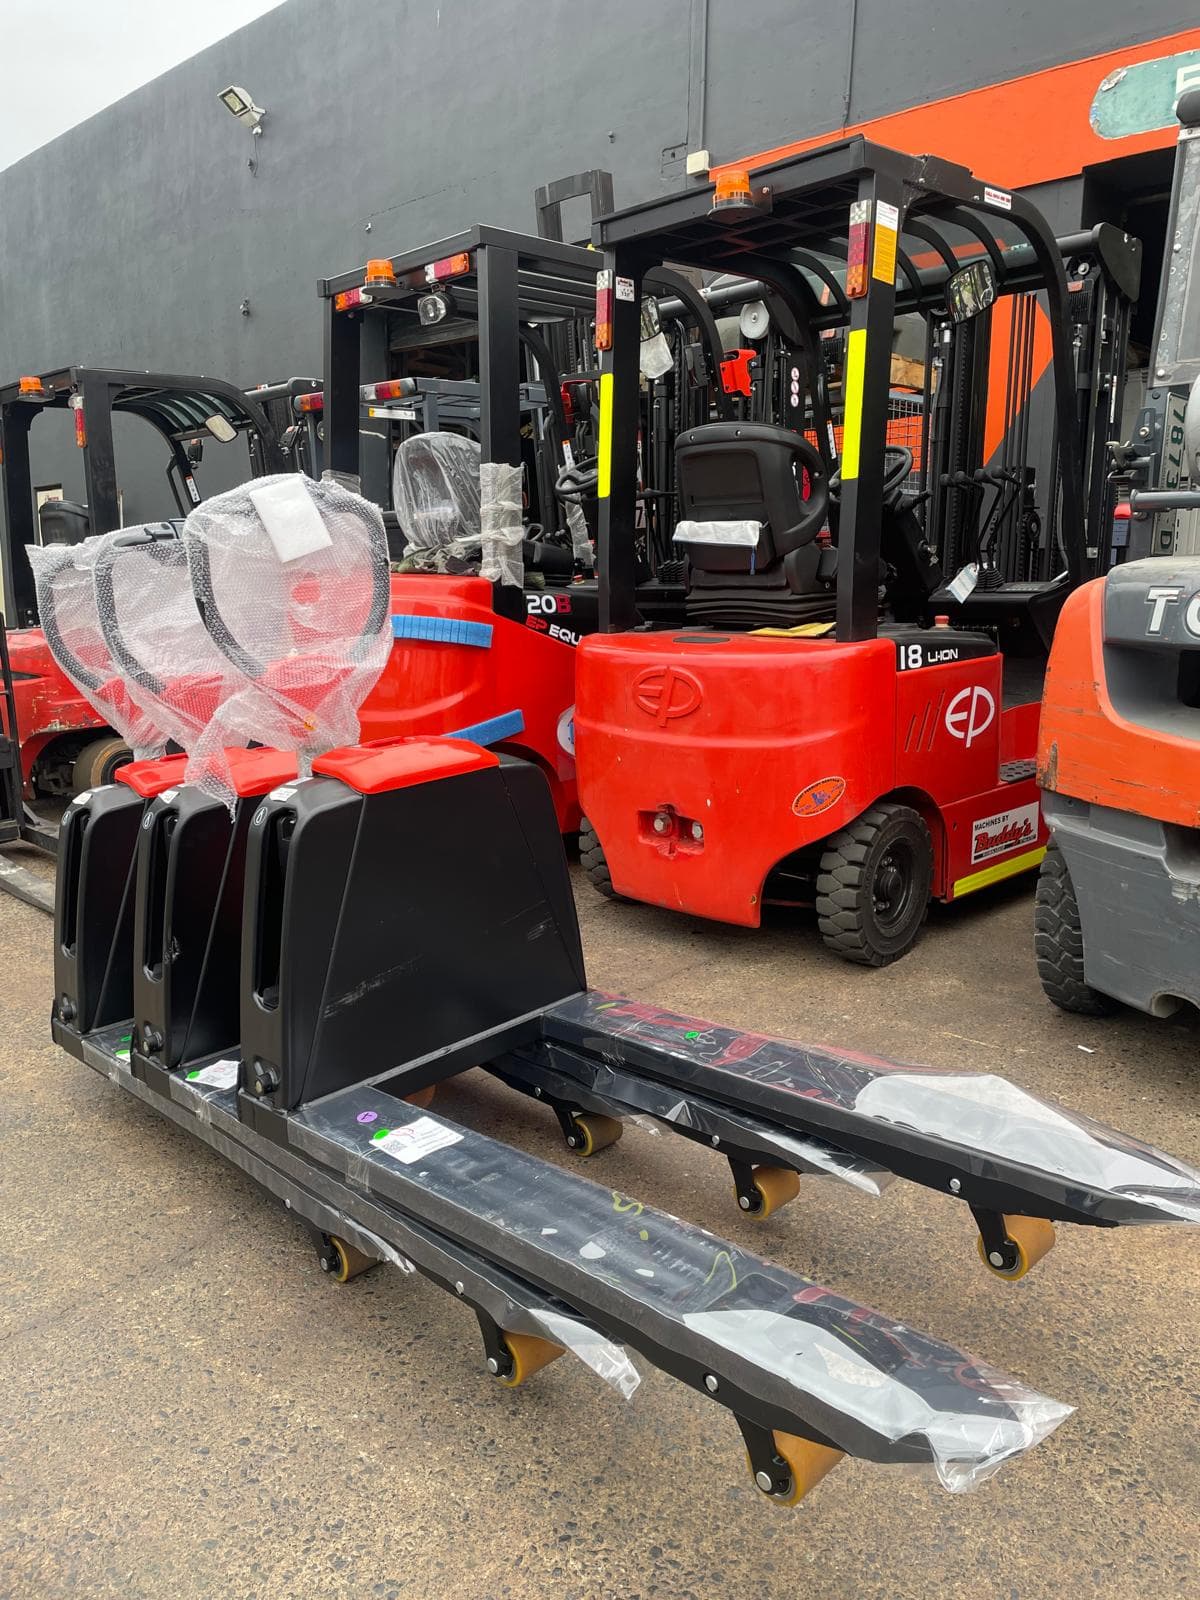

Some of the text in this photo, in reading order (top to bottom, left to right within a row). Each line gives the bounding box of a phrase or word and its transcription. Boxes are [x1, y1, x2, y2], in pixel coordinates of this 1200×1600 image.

[526, 593, 572, 614] 20B
[525, 615, 548, 631] EP
[900, 644, 923, 670] 18
[945, 685, 996, 748] EP
[974, 814, 1010, 831] MACHINES BY
[974, 817, 1034, 854] Buddy's
